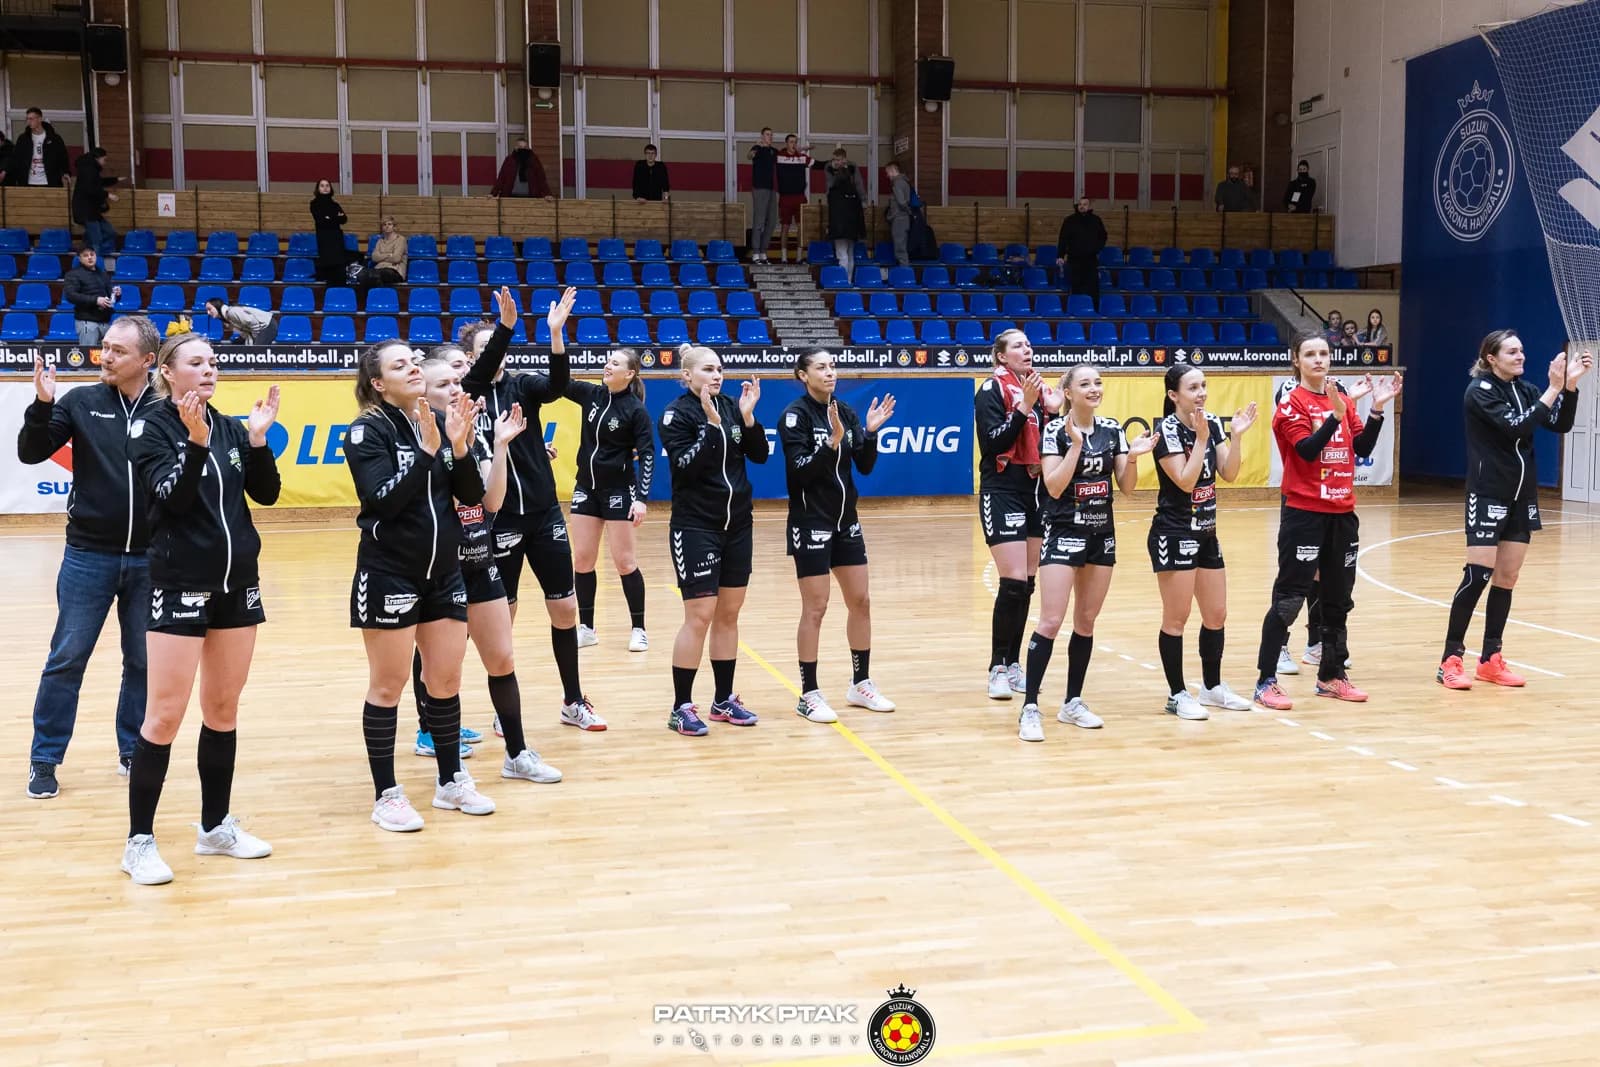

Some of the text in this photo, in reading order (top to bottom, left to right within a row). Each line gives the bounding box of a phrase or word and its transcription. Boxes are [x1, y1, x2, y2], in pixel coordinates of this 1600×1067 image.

[1460, 119, 1489, 139] SUZUKI
[163, 203, 170, 211] A
[1441, 179, 1504, 231] KORONA HANDBALL
[874, 426, 961, 454] GNiG
[1083, 456, 1104, 475] 23
